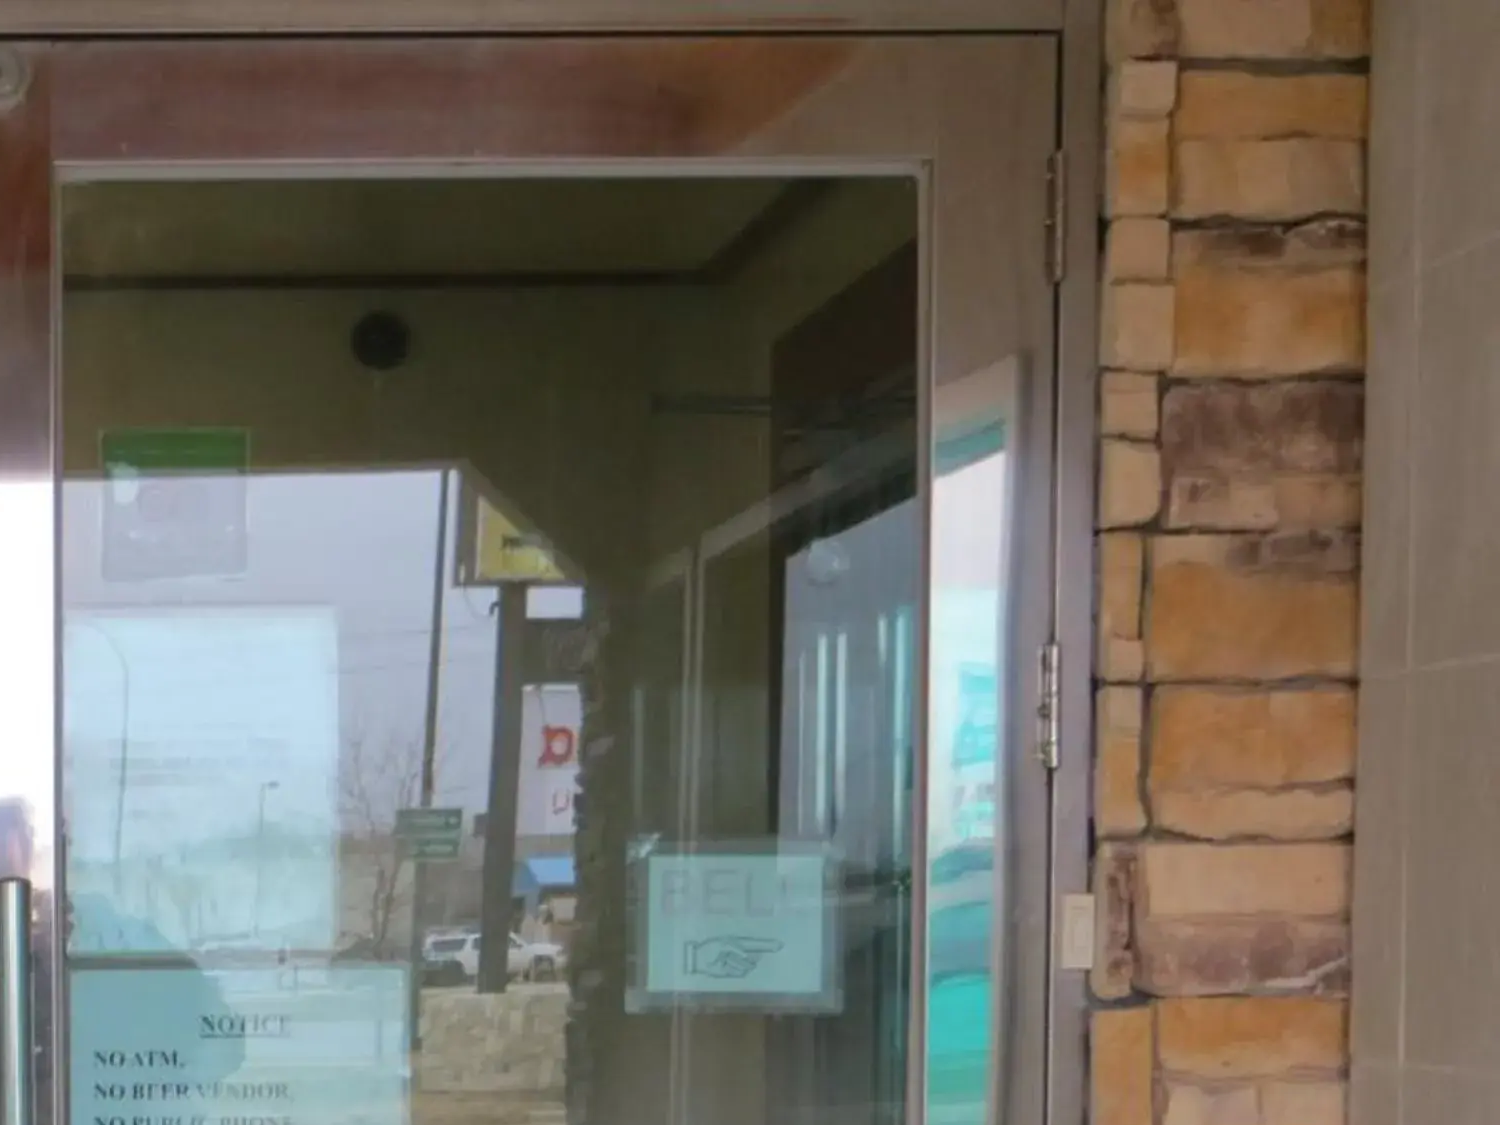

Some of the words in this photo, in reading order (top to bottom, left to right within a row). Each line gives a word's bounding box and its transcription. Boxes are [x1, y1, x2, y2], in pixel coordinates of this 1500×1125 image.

[198, 1014, 293, 1035] NOTICE
[93, 1050, 126, 1068] NO
[93, 1082, 126, 1101] NO
[132, 1082, 190, 1101] BEER
